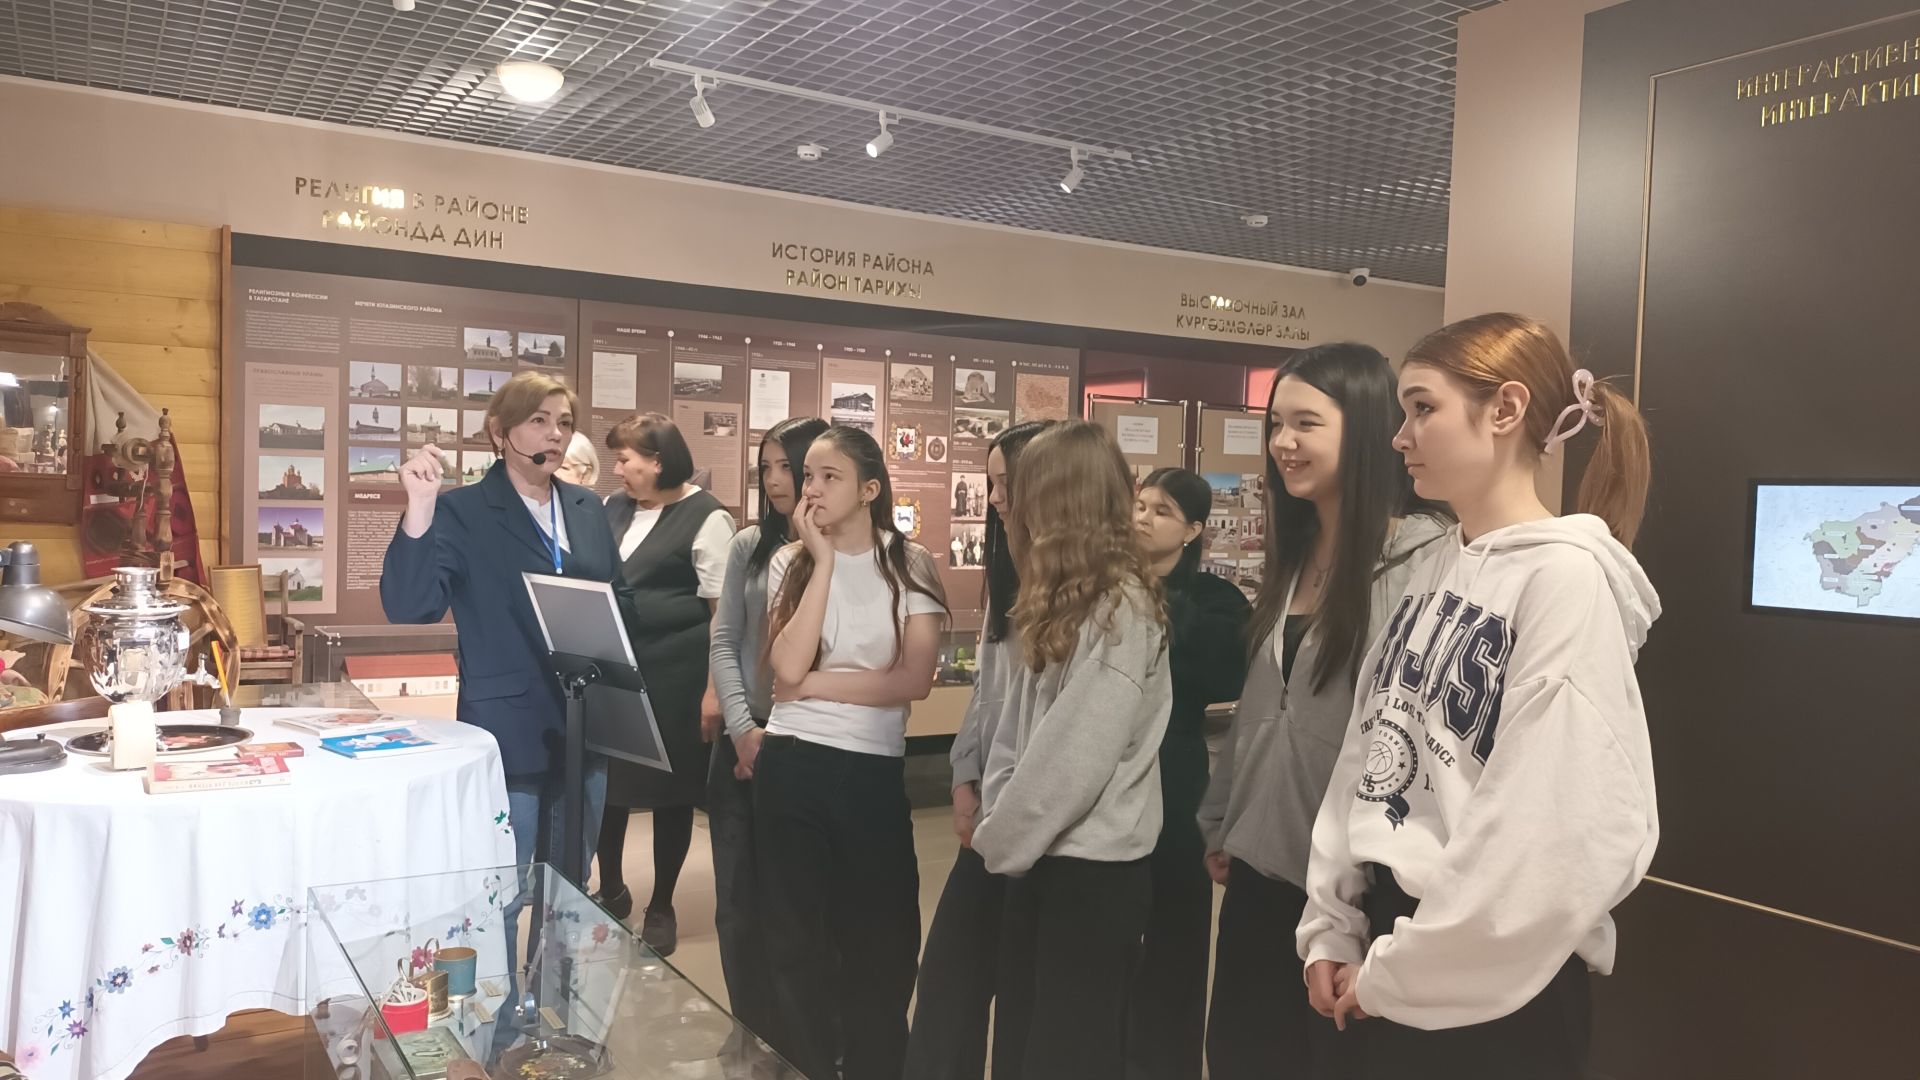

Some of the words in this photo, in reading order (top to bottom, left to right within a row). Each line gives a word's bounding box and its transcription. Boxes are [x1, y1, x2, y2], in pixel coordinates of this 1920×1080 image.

[412, 193, 425, 210] В
[434, 195, 529, 225] РАЙОНЕ
[322, 208, 446, 243] РАЙОНДА
[453, 227, 504, 250] ДИН
[772, 241, 856, 267] ИСТОРИЯ
[862, 253, 934, 276] РАЙОНА
[786, 269, 850, 292] РАЙОН
[854, 276, 922, 299] ТАРИХЫ
[1180, 292, 1278, 319] ВЫСТАВОЧНЫЙ
[1281, 304, 1306, 320] ЗАЛ
[1275, 324, 1310, 341] ЗАЛЫ
